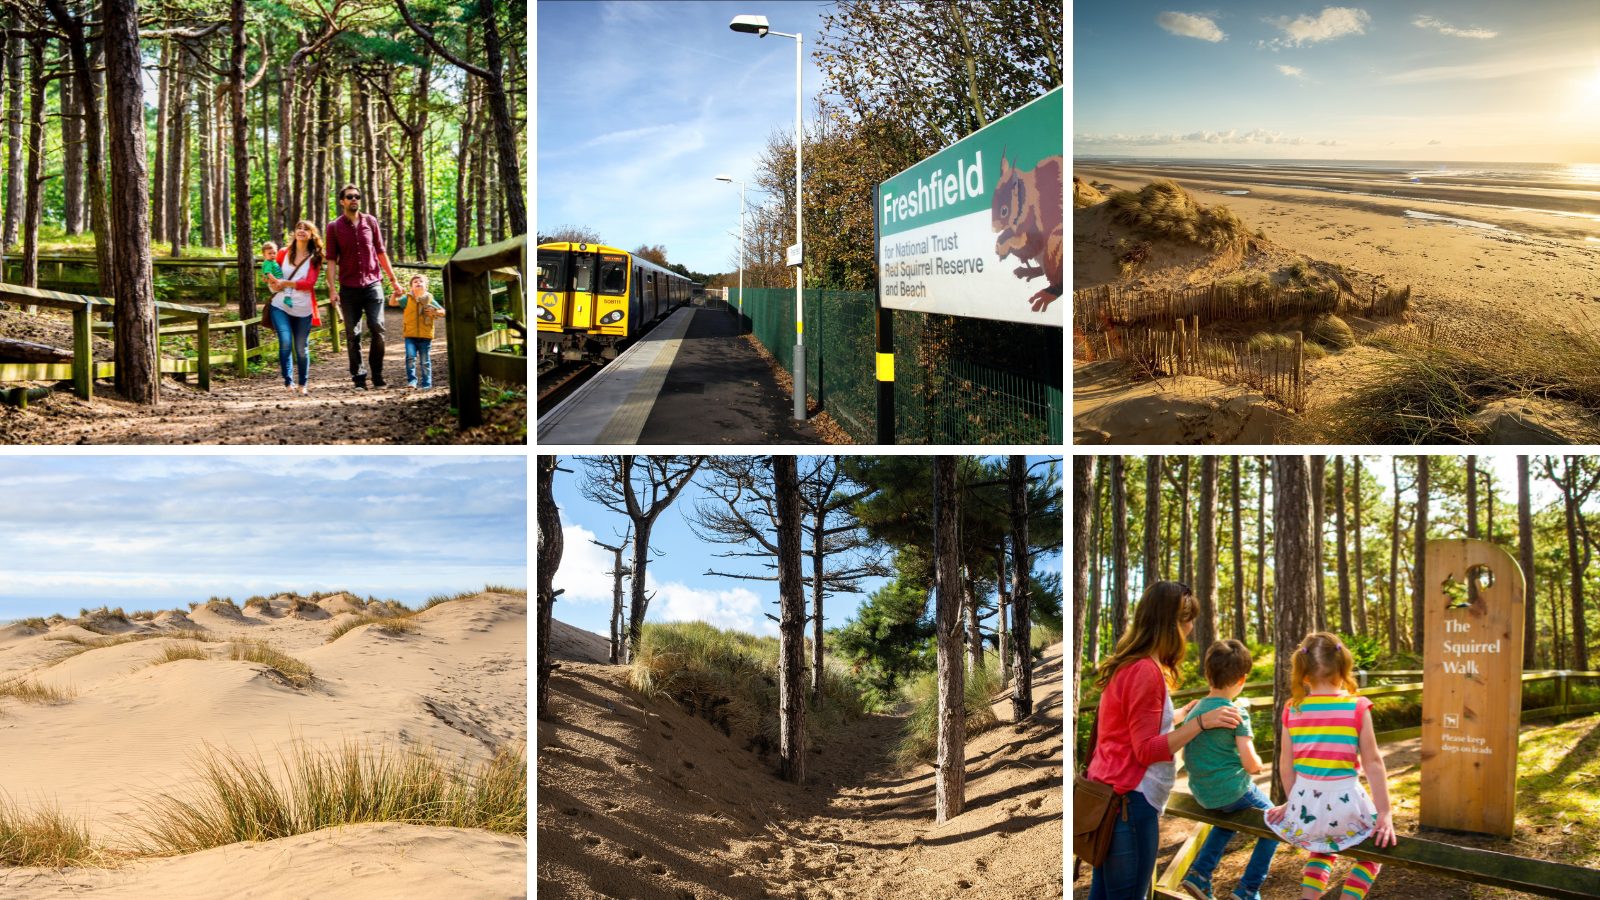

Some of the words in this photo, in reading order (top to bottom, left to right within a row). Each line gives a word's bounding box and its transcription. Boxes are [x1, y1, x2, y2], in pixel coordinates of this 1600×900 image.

[883, 151, 984, 225] Freshfield
[884, 244, 894, 258] for
[896, 236, 929, 258] National
[931, 232, 959, 253] Trust
[885, 262, 899, 278] Red
[900, 260, 934, 281] Squirrel
[936, 257, 984, 275] Reserve
[885, 282, 898, 296] and
[900, 281, 926, 298] Beach
[1444, 619, 1471, 633] The
[1443, 639, 1501, 657] Squirrel
[1442, 660, 1480, 675] Walk
[1441, 733, 1466, 743] Please
[1467, 735, 1486, 746] keep
[1441, 743, 1459, 754] dogs
[1471, 745, 1493, 754] leads
